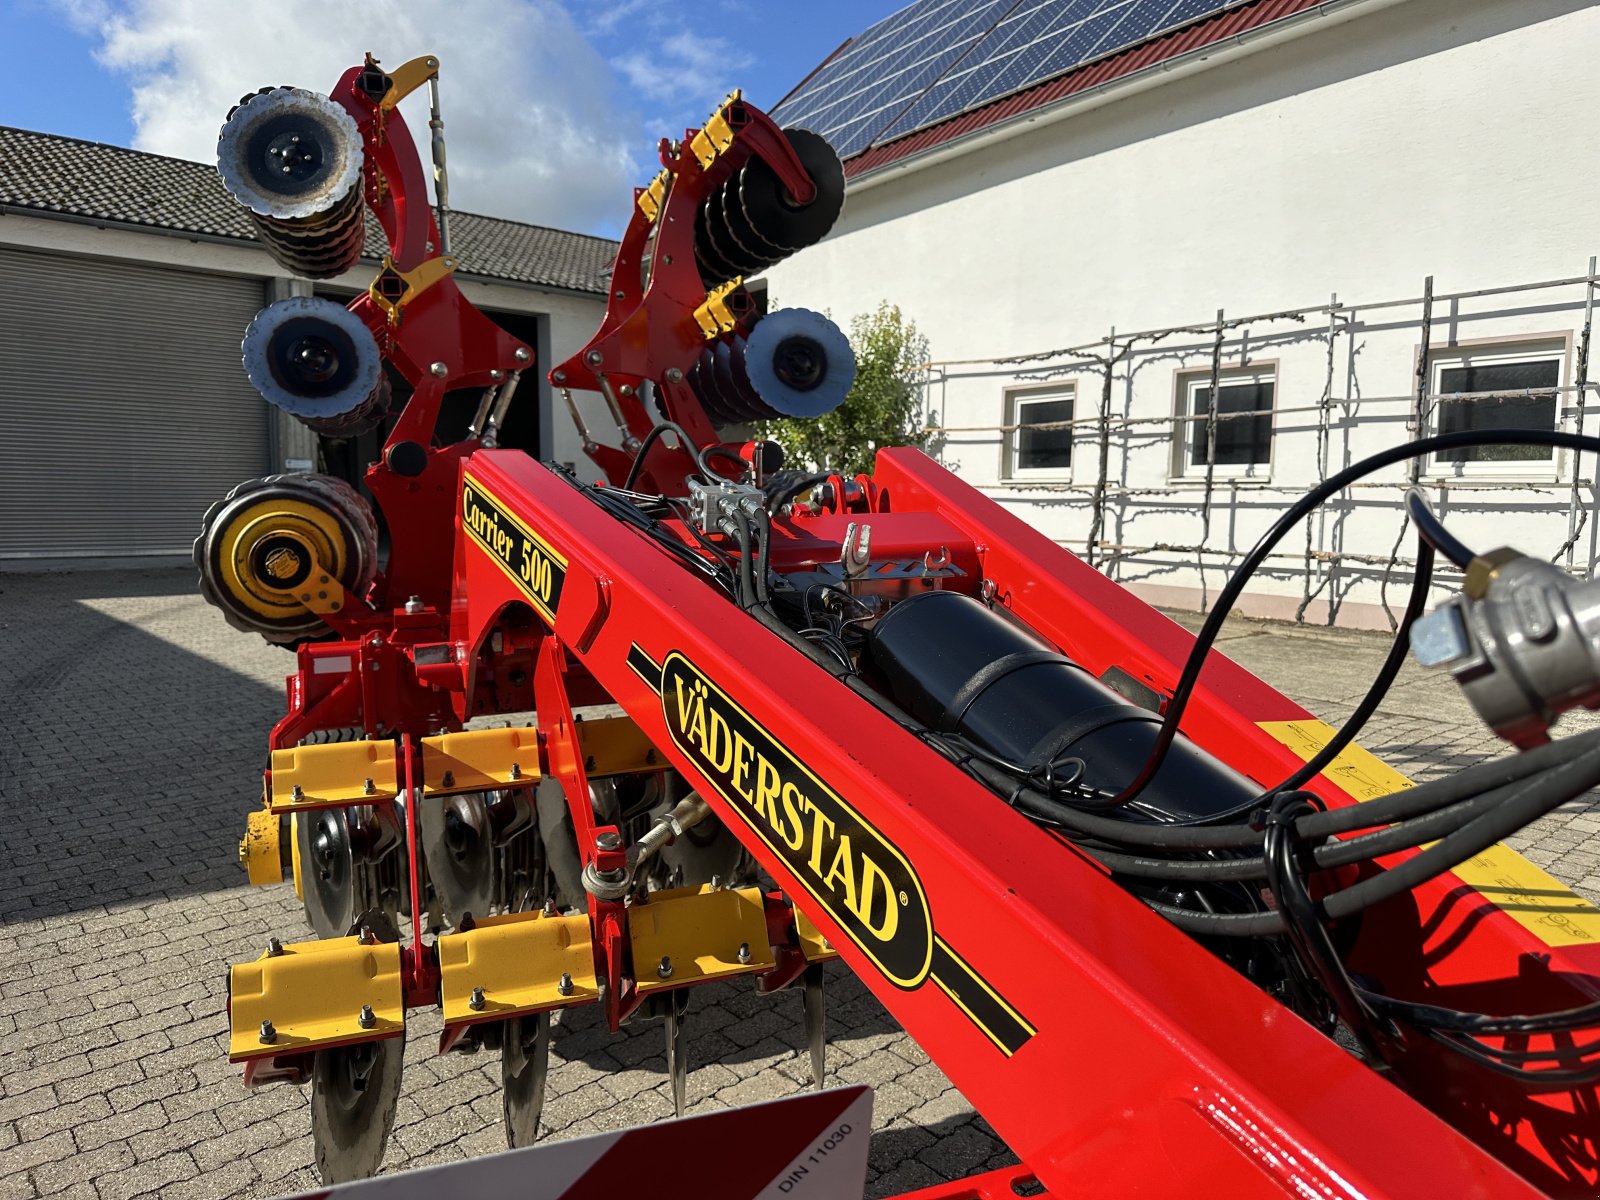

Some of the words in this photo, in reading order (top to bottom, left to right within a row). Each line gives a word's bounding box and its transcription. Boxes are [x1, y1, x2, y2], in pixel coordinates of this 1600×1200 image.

[463, 486, 514, 562] Carrier
[520, 538, 552, 603] 500
[778, 1165, 810, 1194] DIN
[808, 1123, 852, 1164] 11030
